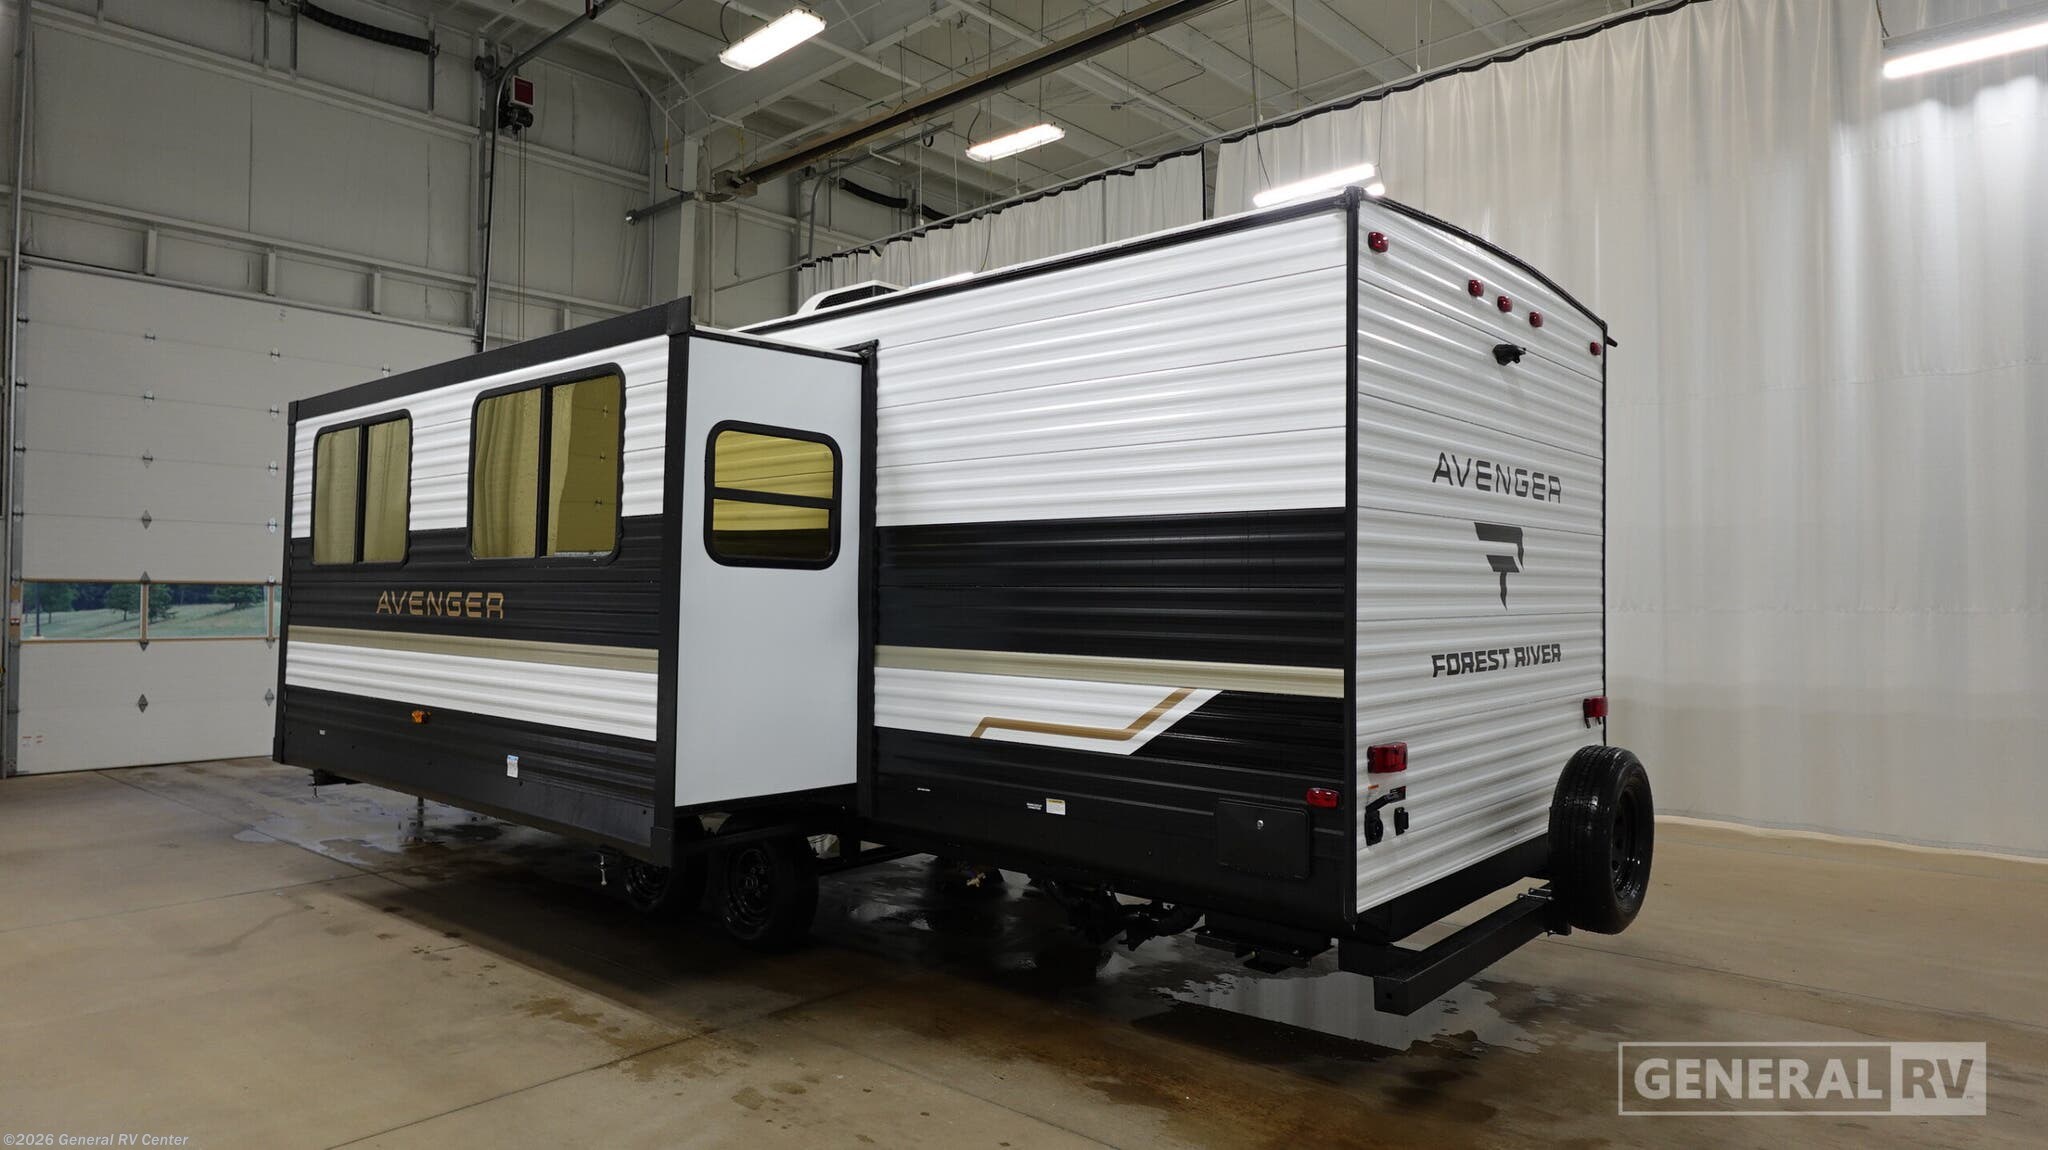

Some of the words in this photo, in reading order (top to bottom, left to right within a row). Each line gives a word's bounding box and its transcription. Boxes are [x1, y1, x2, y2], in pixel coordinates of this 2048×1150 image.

[1431, 451, 1562, 504] AVENGER
[375, 590, 505, 620] AVENGER
[1431, 648, 1510, 678] FOREST
[1513, 643, 1562, 668] RIVER
